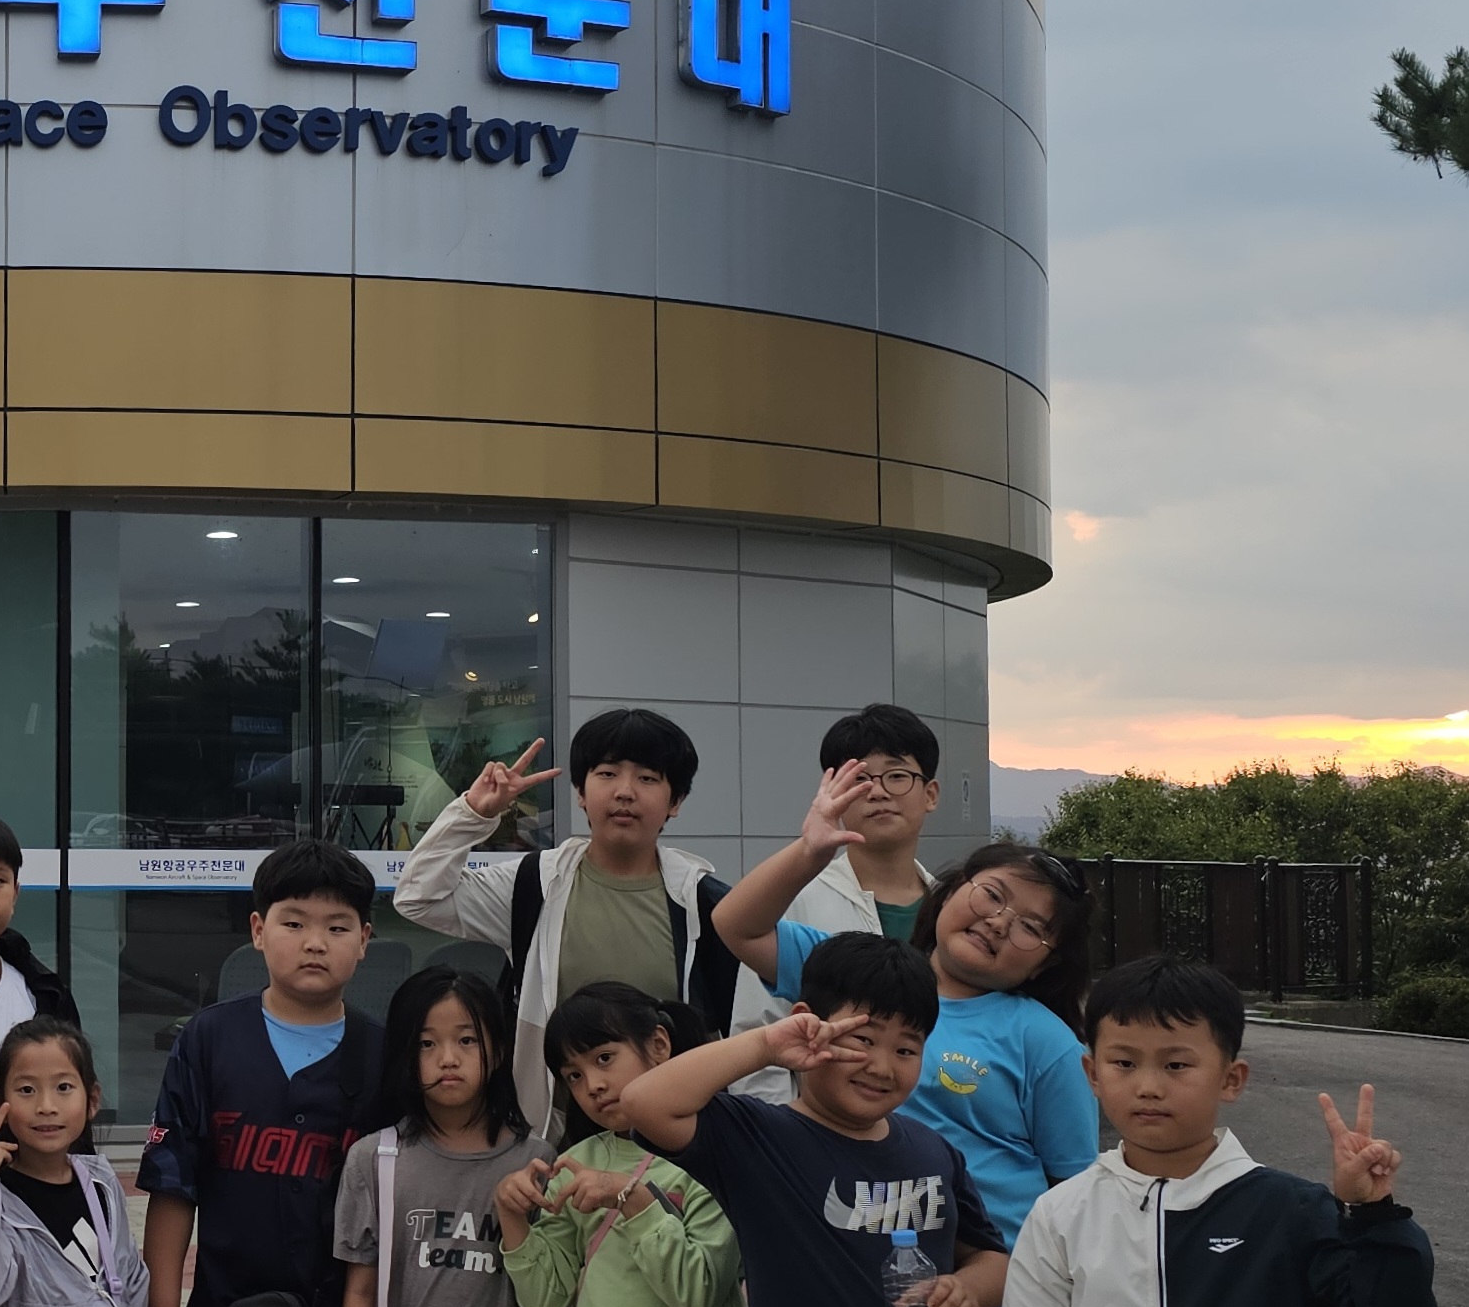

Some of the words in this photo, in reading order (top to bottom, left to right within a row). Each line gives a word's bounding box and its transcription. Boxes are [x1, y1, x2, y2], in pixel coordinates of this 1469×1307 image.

[158, 84, 579, 177] Observatory
[942, 1052, 988, 1076] SMILE
[406, 1208, 503, 1242] TEAM
[847, 1175, 946, 1234] NIKE
